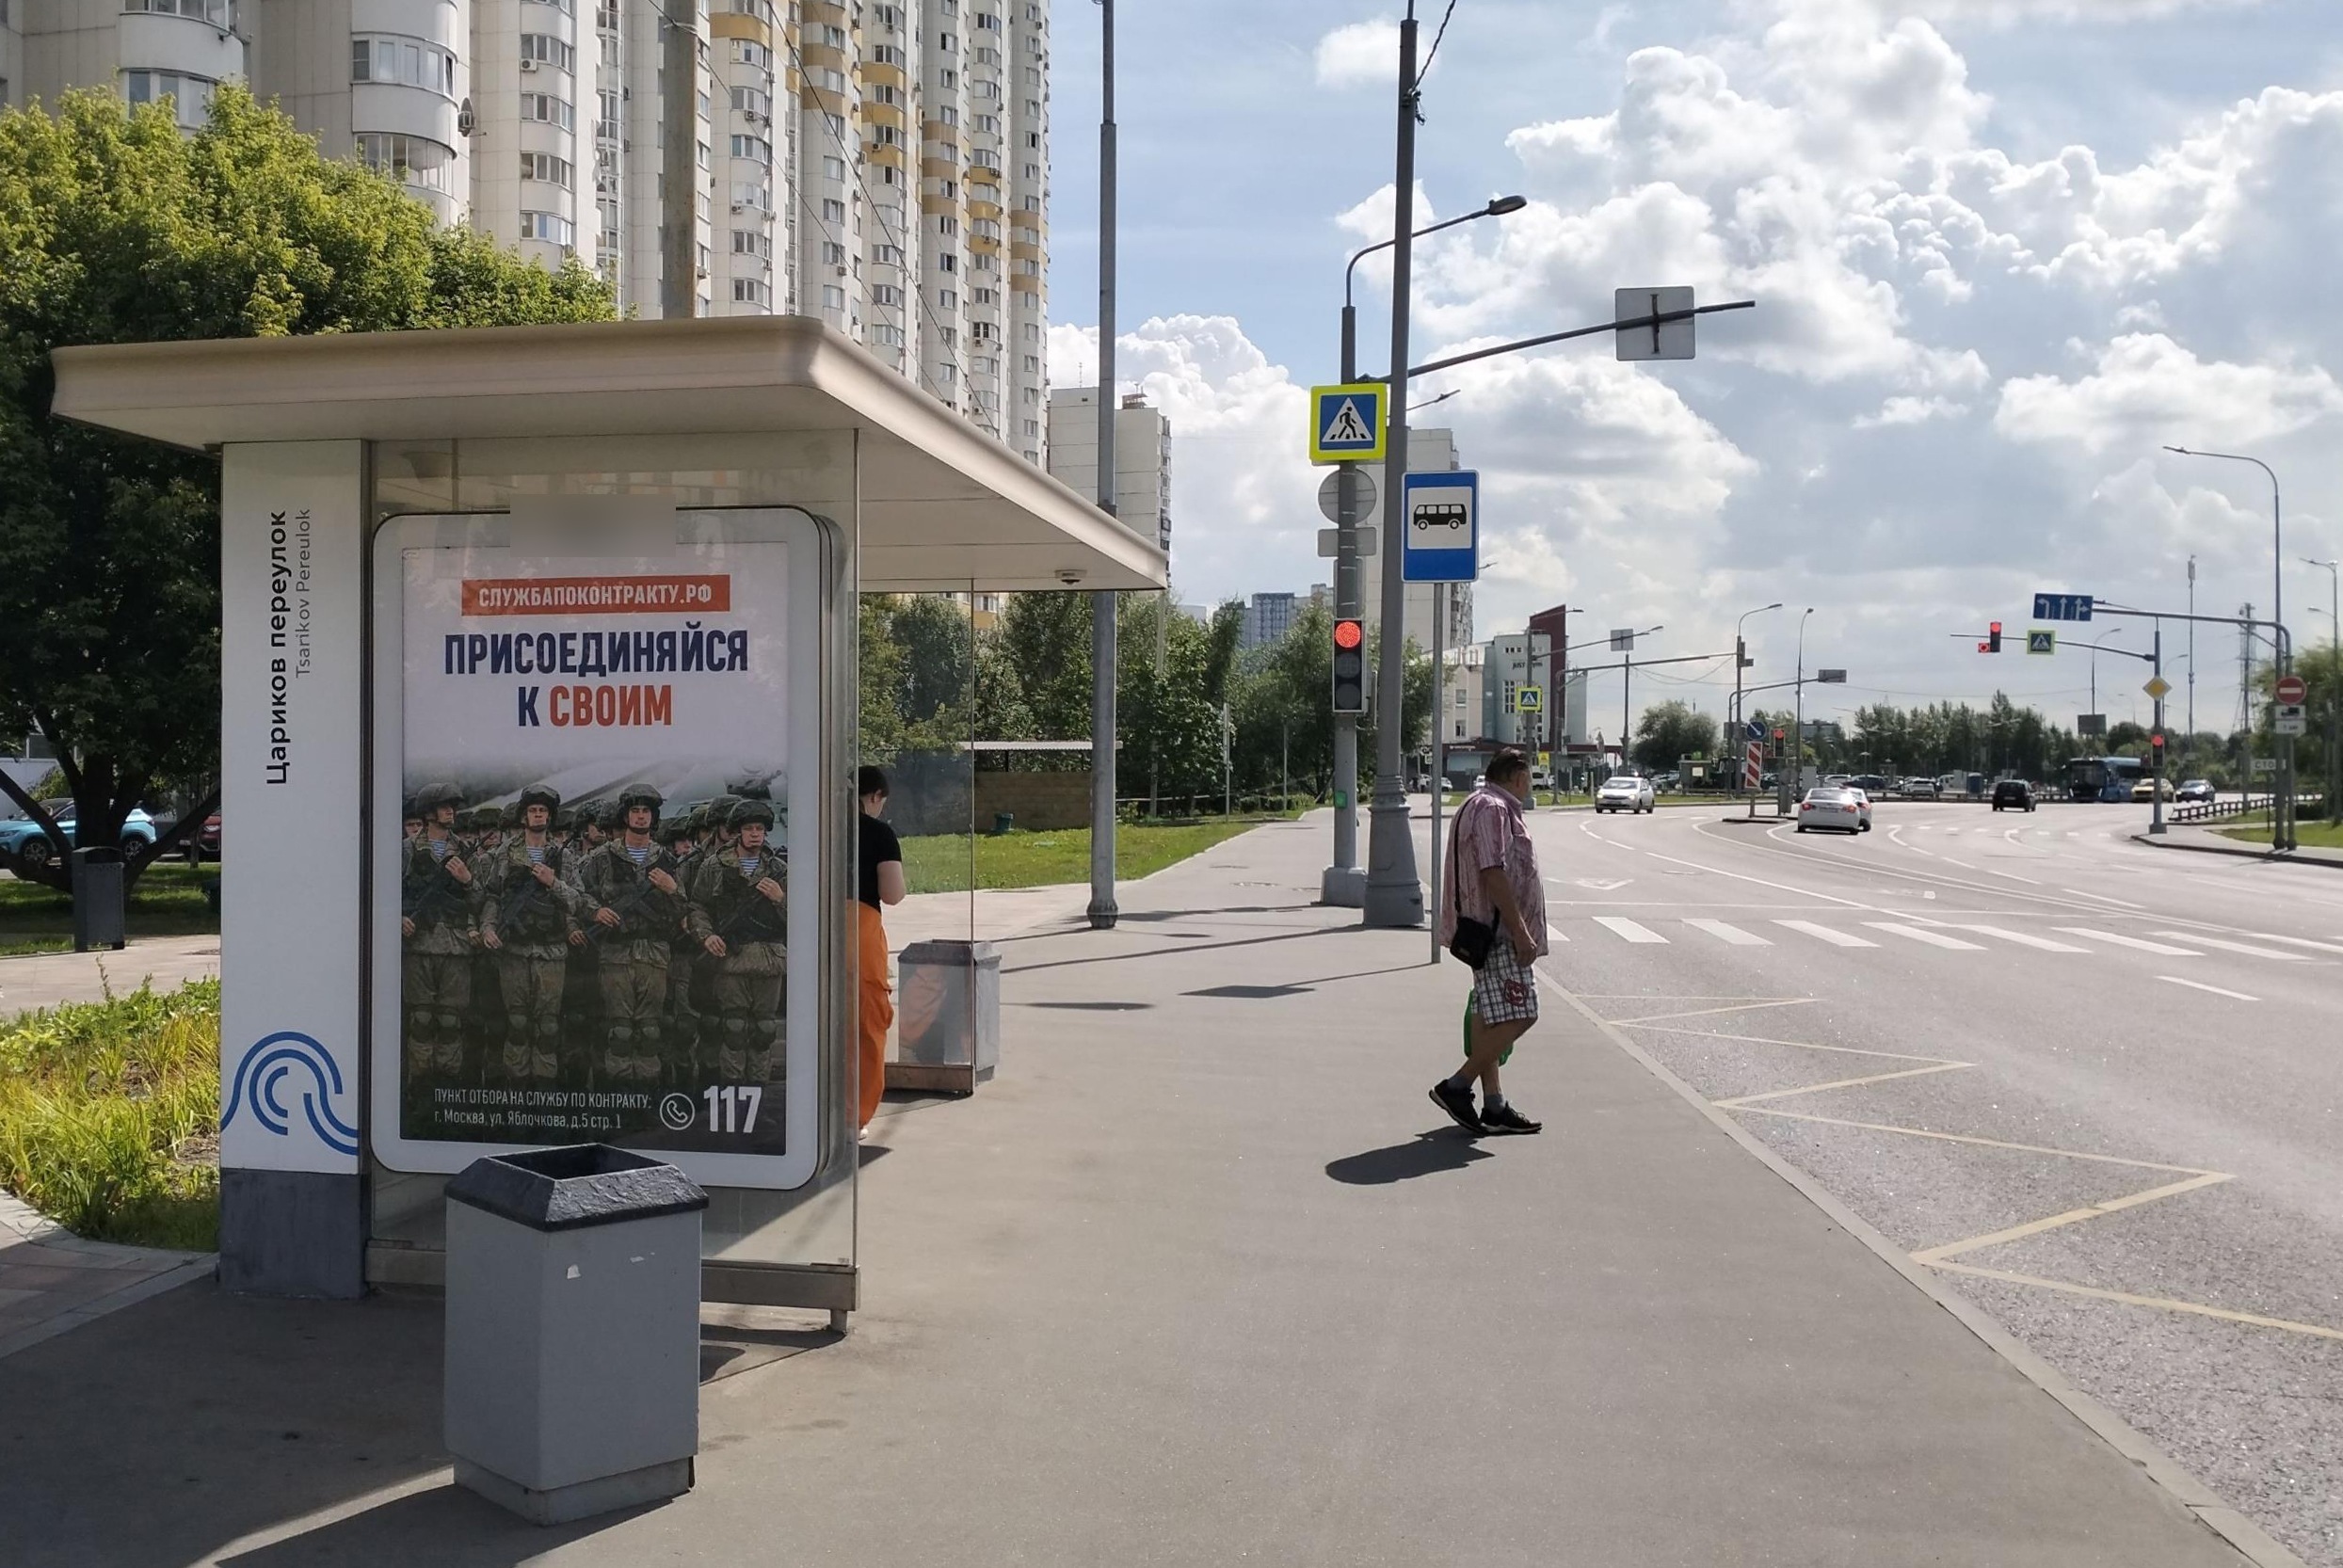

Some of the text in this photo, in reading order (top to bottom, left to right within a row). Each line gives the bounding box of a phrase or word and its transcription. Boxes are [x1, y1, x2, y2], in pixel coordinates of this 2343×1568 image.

[295, 509, 311, 679] Tsarikov Pereulok
[478, 584, 713, 608] СЛУЖБАПОКОНТРАКТУ.РФ
[265, 511, 292, 786] Цариков переулок
[444, 620, 748, 678] ПРИСОЕДИНЯЙСЯ
[518, 684, 672, 727] К СВОИМ
[434, 1088, 652, 1110] ПУНКТ ОТБОРА НА СЛУЖБУ ПО КОНТРАКТУ:
[434, 1112, 441, 1123] г.
[444, 1109, 488, 1126] Москва,
[489, 1112, 505, 1128] ул.
[507, 1111, 570, 1128] Яблочкова,
[590, 1115, 612, 1130] стр.
[616, 1113, 621, 1129] 1
[703, 1085, 762, 1134] 117
